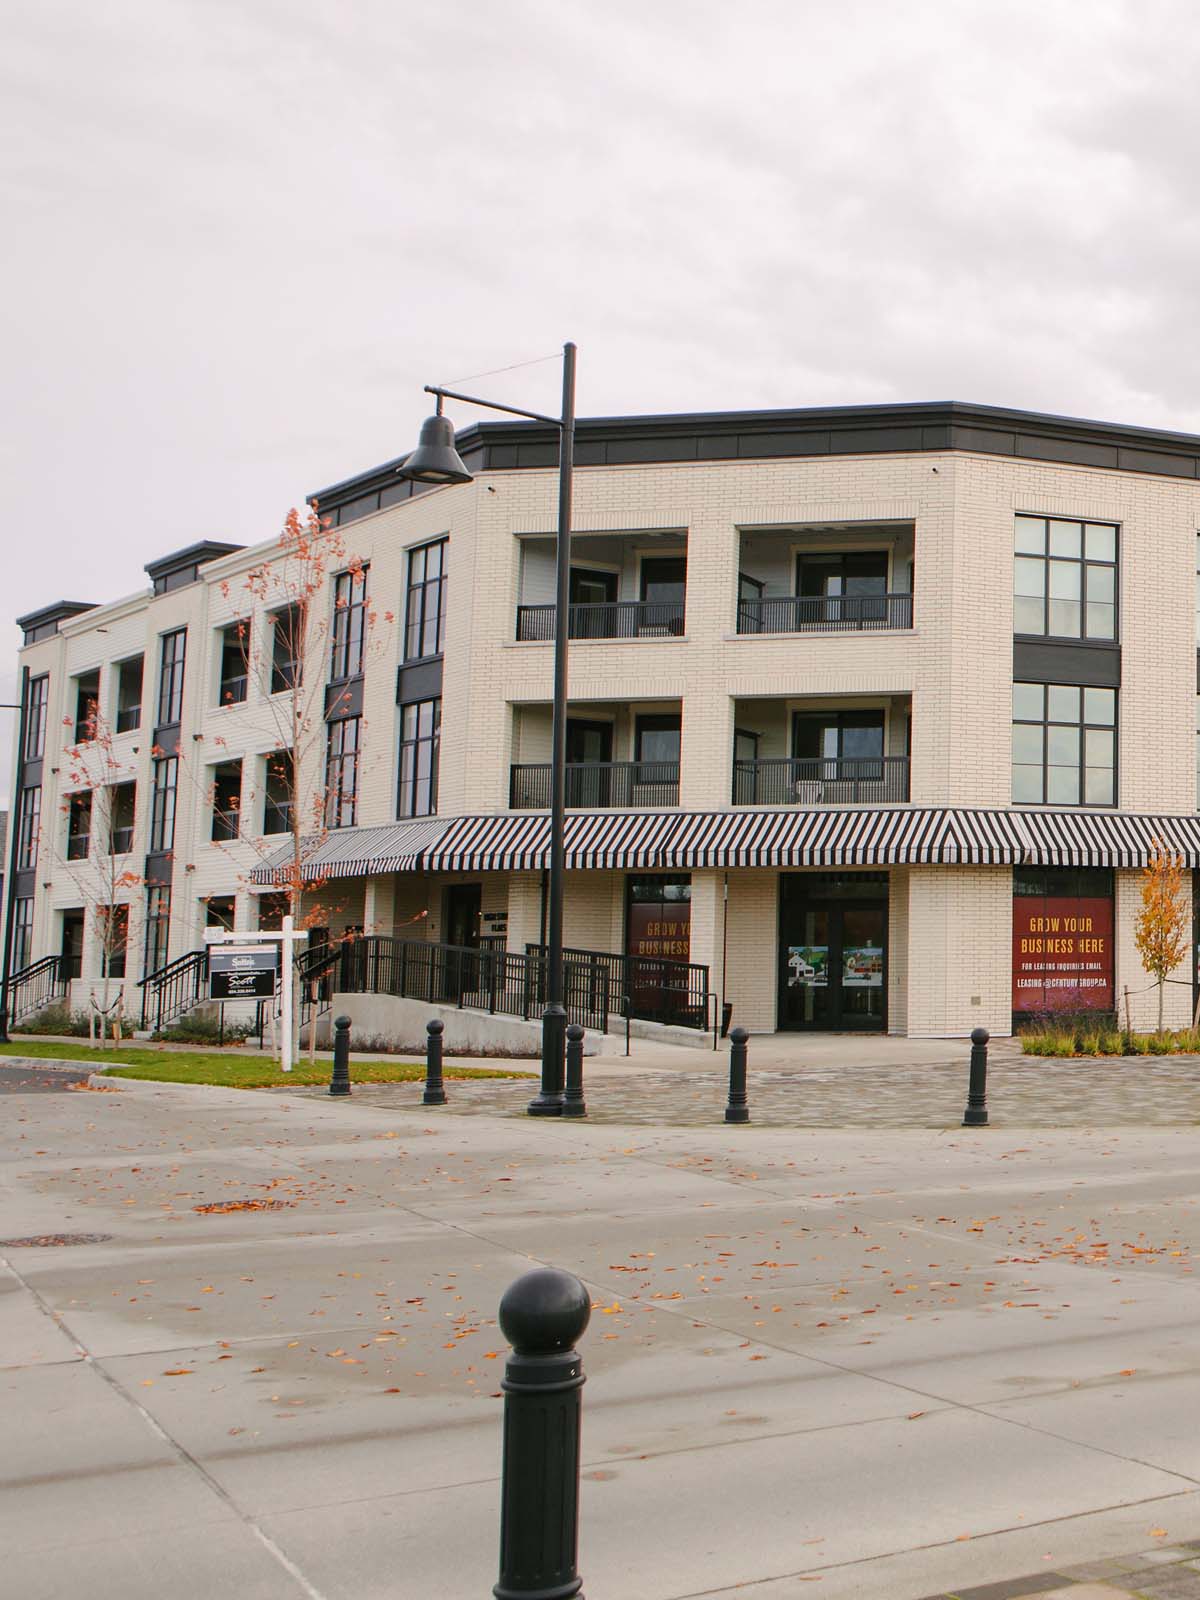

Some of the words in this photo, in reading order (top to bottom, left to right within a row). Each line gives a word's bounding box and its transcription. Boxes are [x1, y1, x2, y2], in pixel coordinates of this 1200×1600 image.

[647, 922, 677, 936] GROW
[1030, 917, 1060, 932] GROW
[1064, 917, 1092, 932] YOUR
[639, 941, 688, 955] BUSINESS
[1021, 939, 1073, 953] BUSINESS
[1078, 939, 1104, 953] HERE
